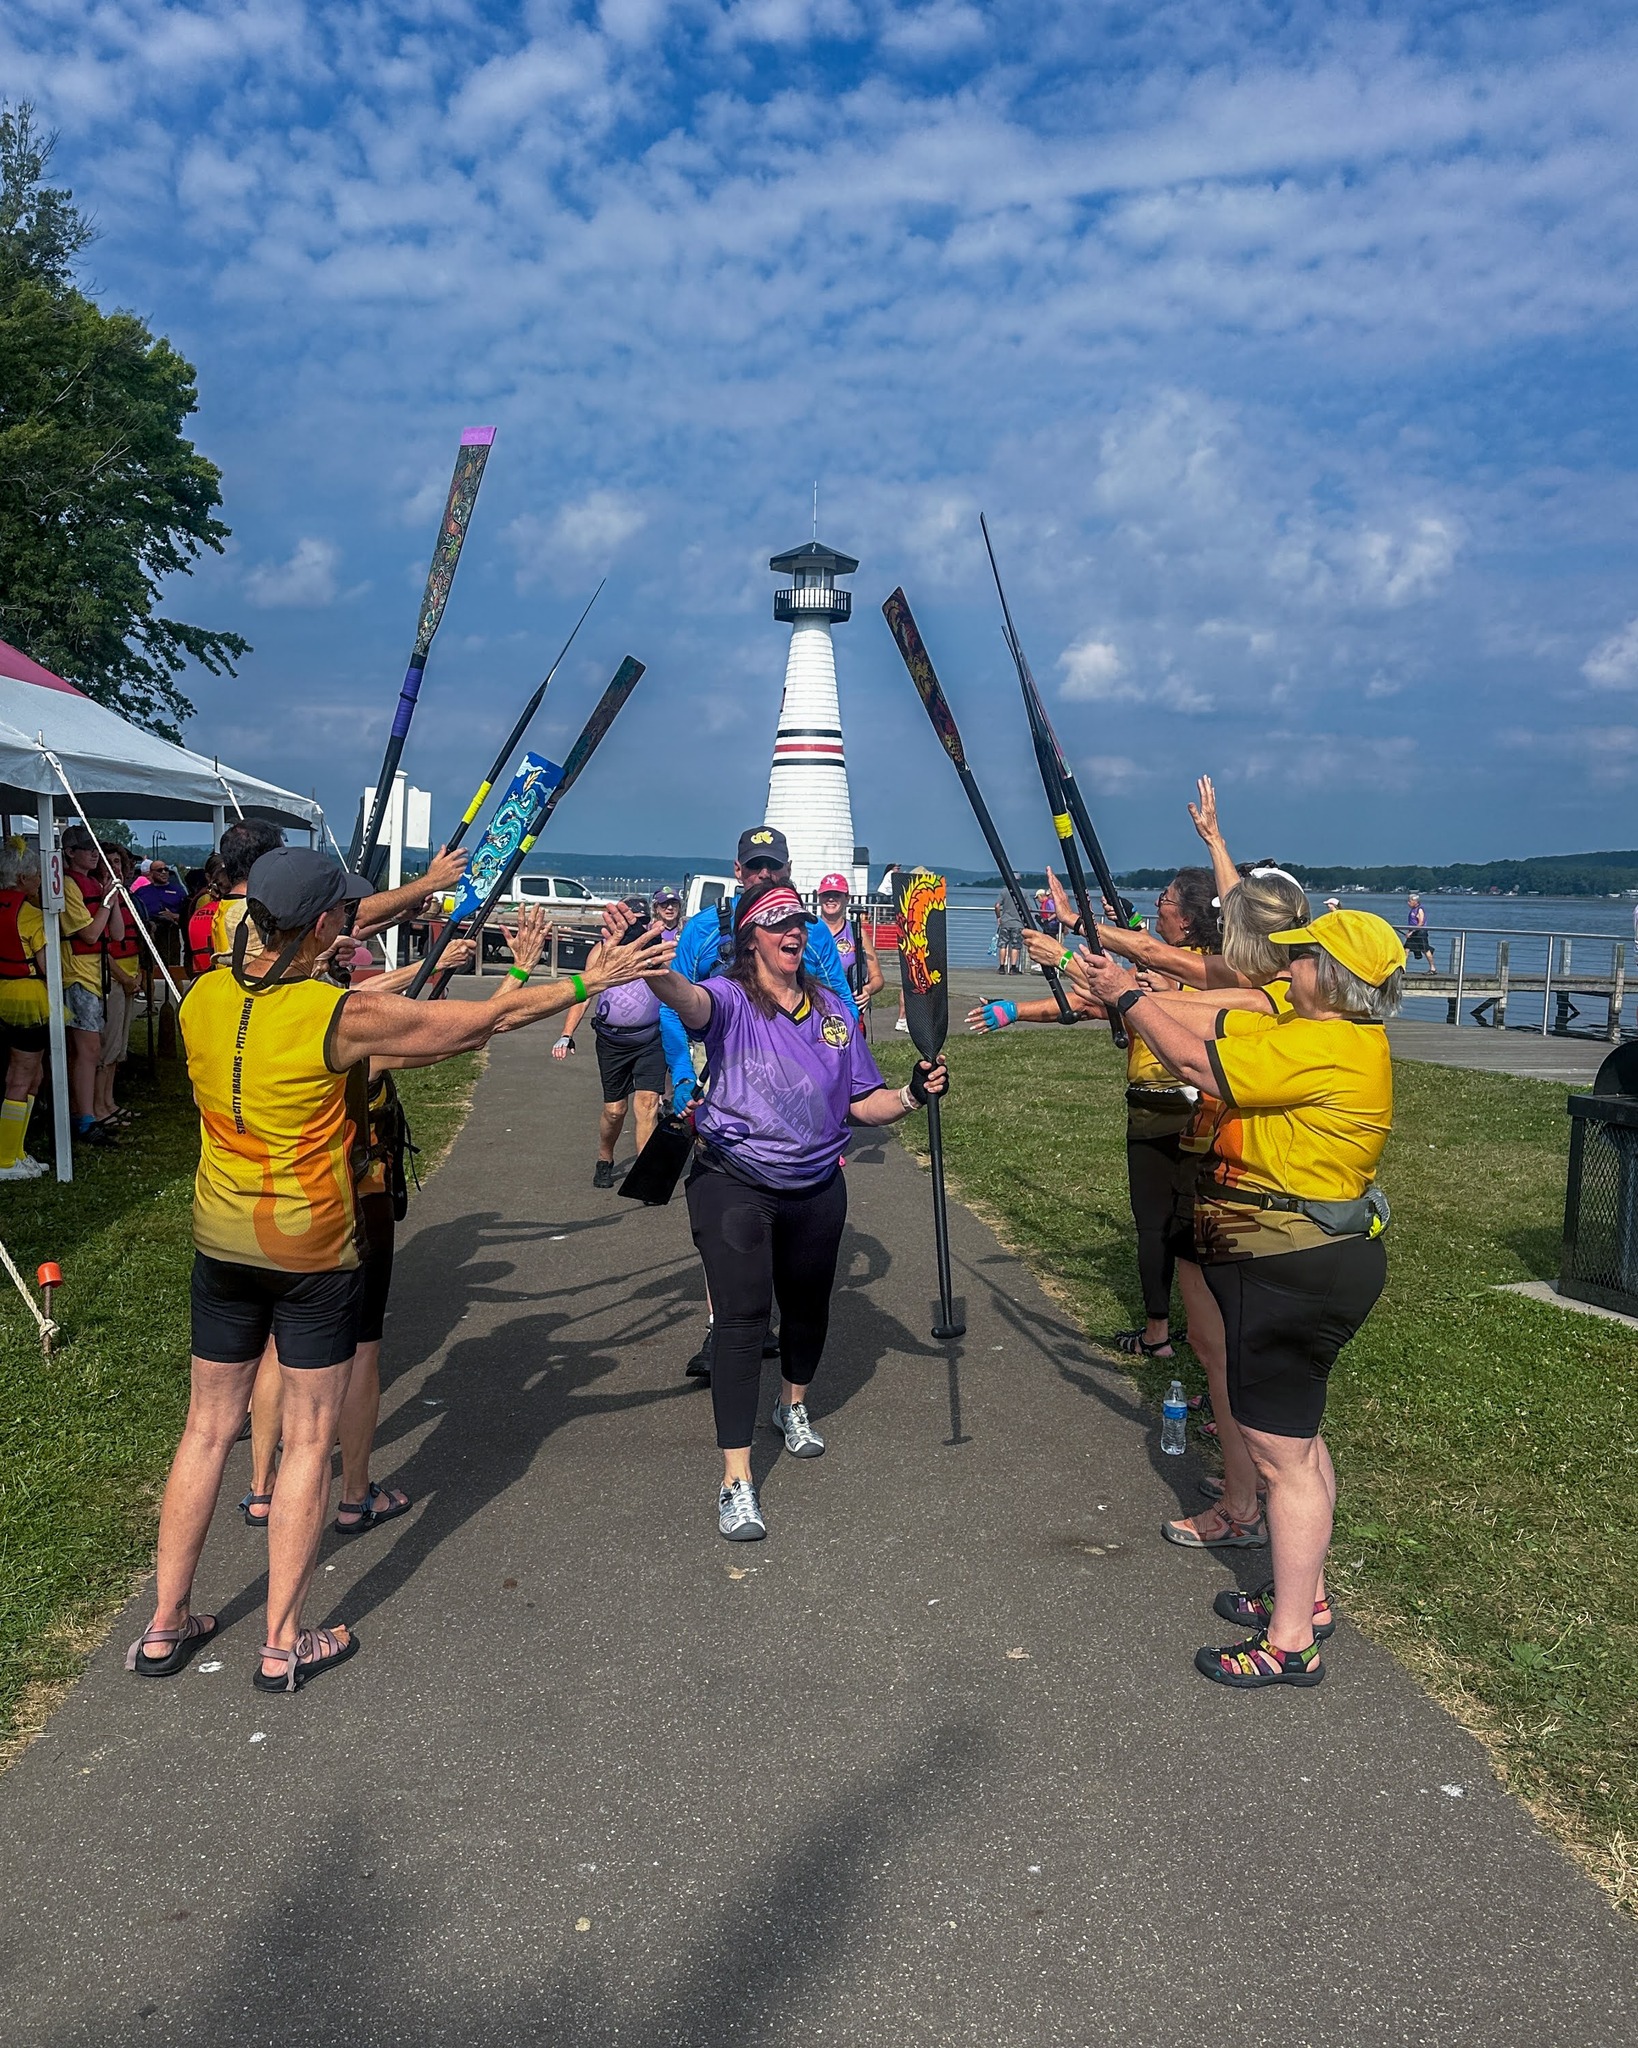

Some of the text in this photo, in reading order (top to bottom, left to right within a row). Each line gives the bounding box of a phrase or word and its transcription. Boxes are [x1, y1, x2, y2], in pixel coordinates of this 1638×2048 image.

[51, 855, 61, 896] 3
[825, 876, 840, 887] NY
[232, 998, 254, 1134] STEEL CITY DRAGONS PITTSBURGH
